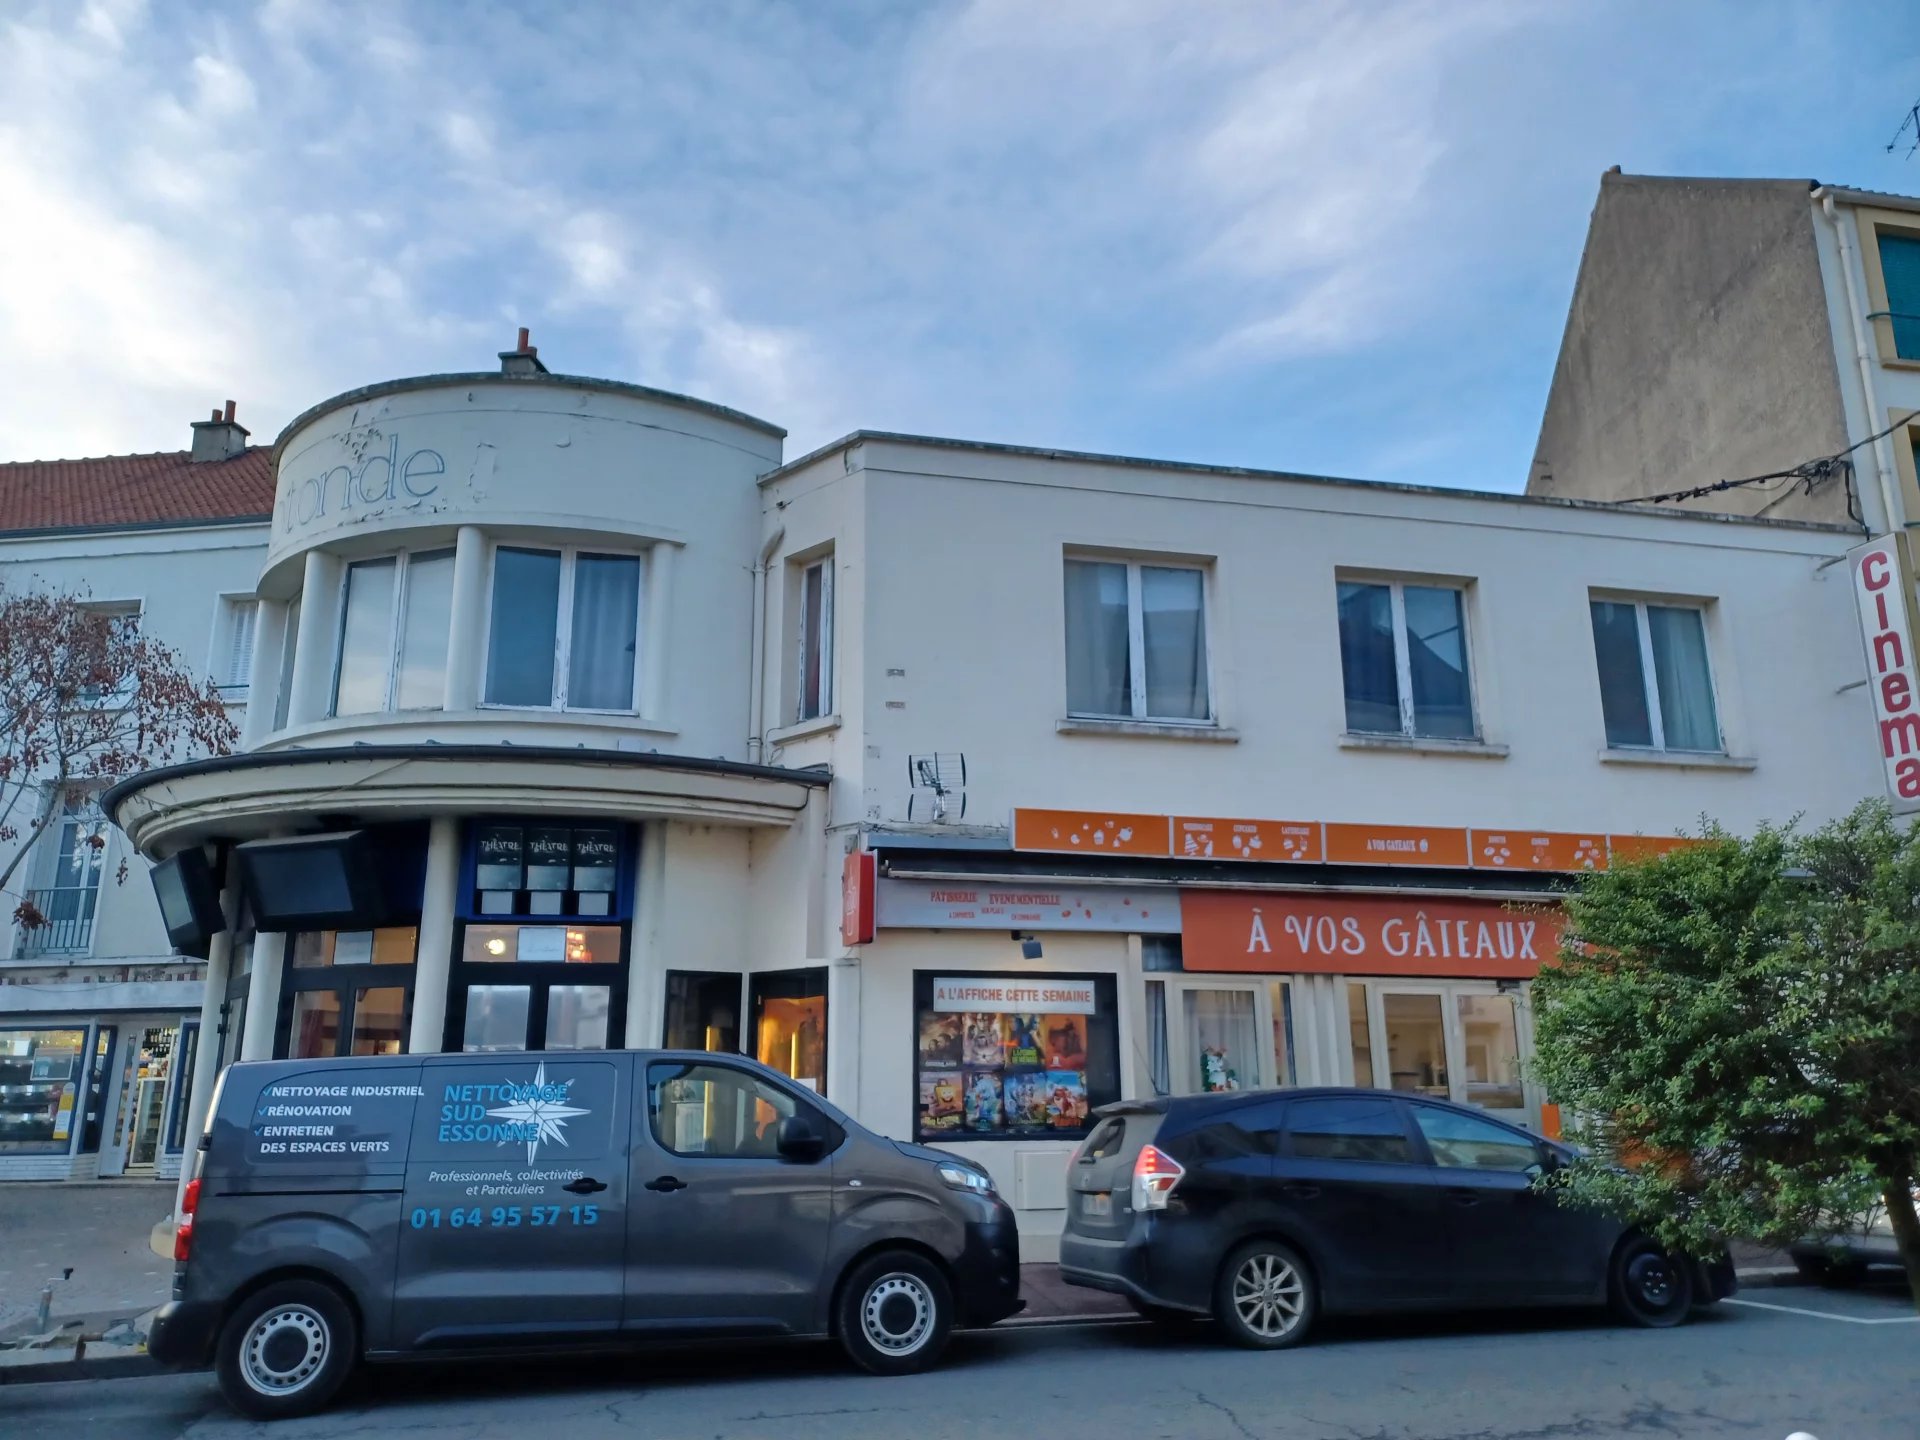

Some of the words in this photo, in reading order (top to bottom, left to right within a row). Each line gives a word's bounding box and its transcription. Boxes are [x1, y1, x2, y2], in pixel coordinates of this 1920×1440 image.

[1247, 908, 1271, 952] À
[1285, 915, 1366, 955] VOS
[1381, 910, 1538, 959] GÂTEAUX
[937, 987, 945, 999] A
[948, 987, 1002, 1001] L'AFFICHE
[1006, 989, 1039, 1002] CETTE
[1042, 989, 1091, 1003] SEMAINE
[271, 1086, 349, 1097] NETTOYAGE
[351, 1086, 425, 1097] INDUSTRIEL
[444, 1084, 568, 1102] NETTOYAGE
[267, 1104, 352, 1117] RÉNOVATION
[440, 1104, 486, 1122] SUD
[263, 1125, 334, 1137] ENTRETIEN
[438, 1123, 539, 1142] ESSONNE
[260, 1143, 286, 1153] DES
[289, 1142, 346, 1153] ESPACES
[350, 1141, 390, 1152] VERTS
[428, 1169, 513, 1183] Professionnels,
[517, 1167, 584, 1180] collectivités
[465, 1184, 478, 1196] et
[481, 1183, 545, 1195] Particuliers
[411, 1207, 441, 1230] 01
[450, 1206, 482, 1229] 64
[491, 1206, 522, 1227] 95
[530, 1205, 561, 1227] 57
[569, 1203, 599, 1226] 15
